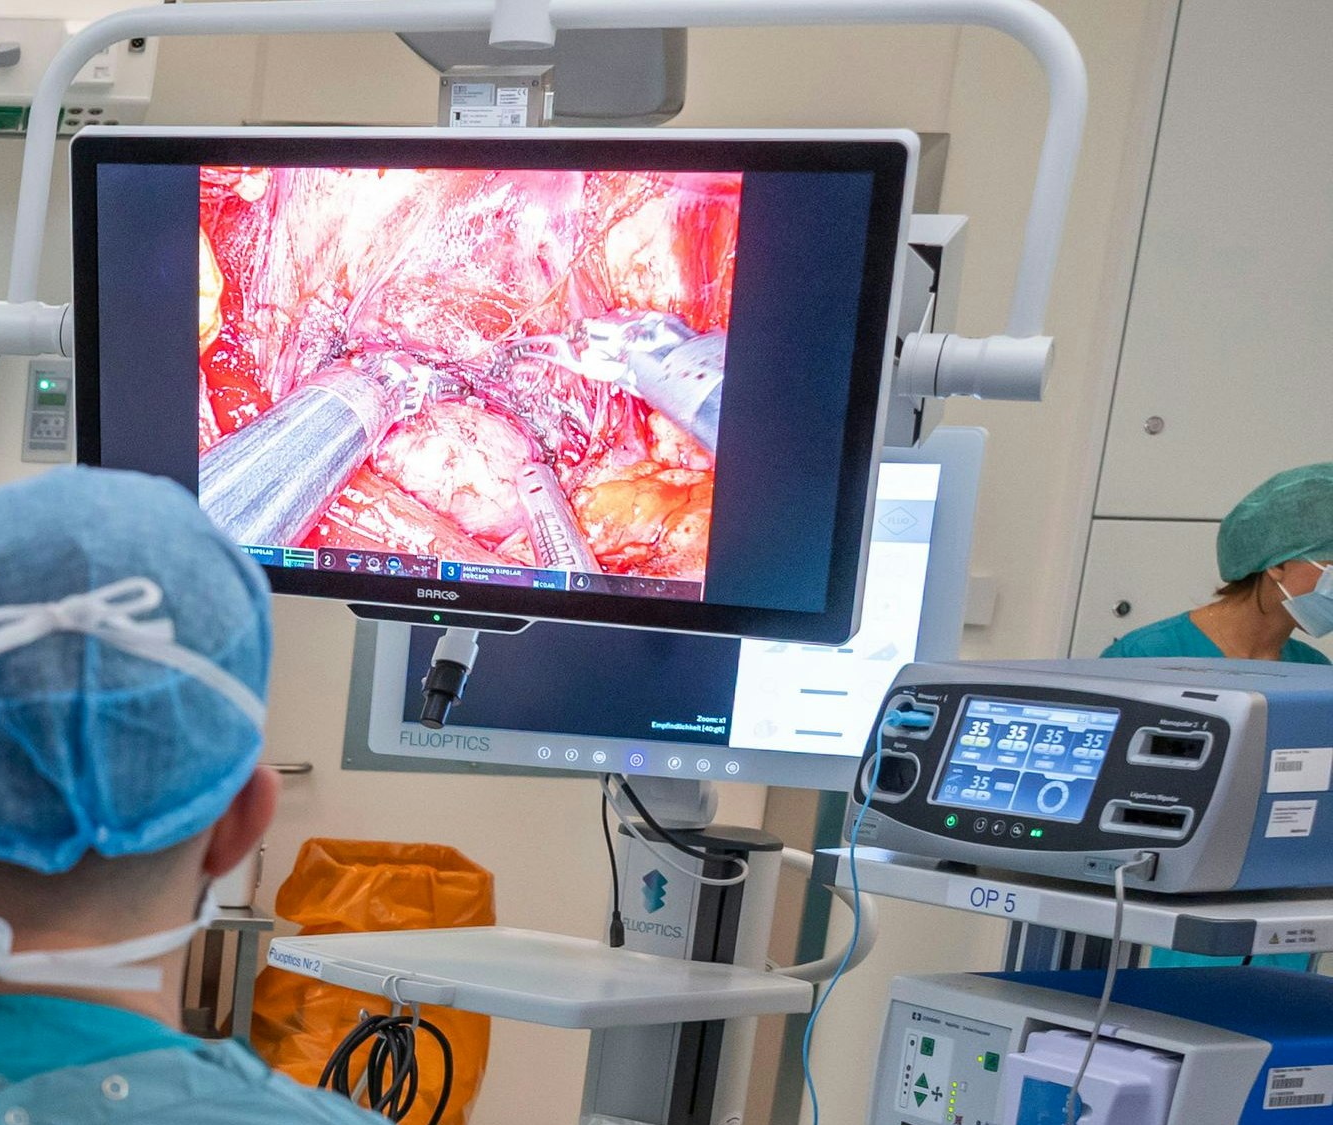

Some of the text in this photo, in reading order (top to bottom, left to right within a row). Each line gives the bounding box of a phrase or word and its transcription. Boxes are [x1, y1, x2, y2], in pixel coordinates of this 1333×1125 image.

[463, 566, 495, 574] MARYLAND
[416, 588, 459, 601] BARCO
[696, 715, 718, 723] Zoom:
[968, 720, 991, 736] 35
[1006, 724, 1029, 741] 35
[1043, 728, 1064, 744] 35
[399, 730, 491, 752] FLUOPTICS
[1082, 732, 1104, 748] 35
[969, 775, 991, 790] 35
[970, 886, 1017, 913] OP 5
